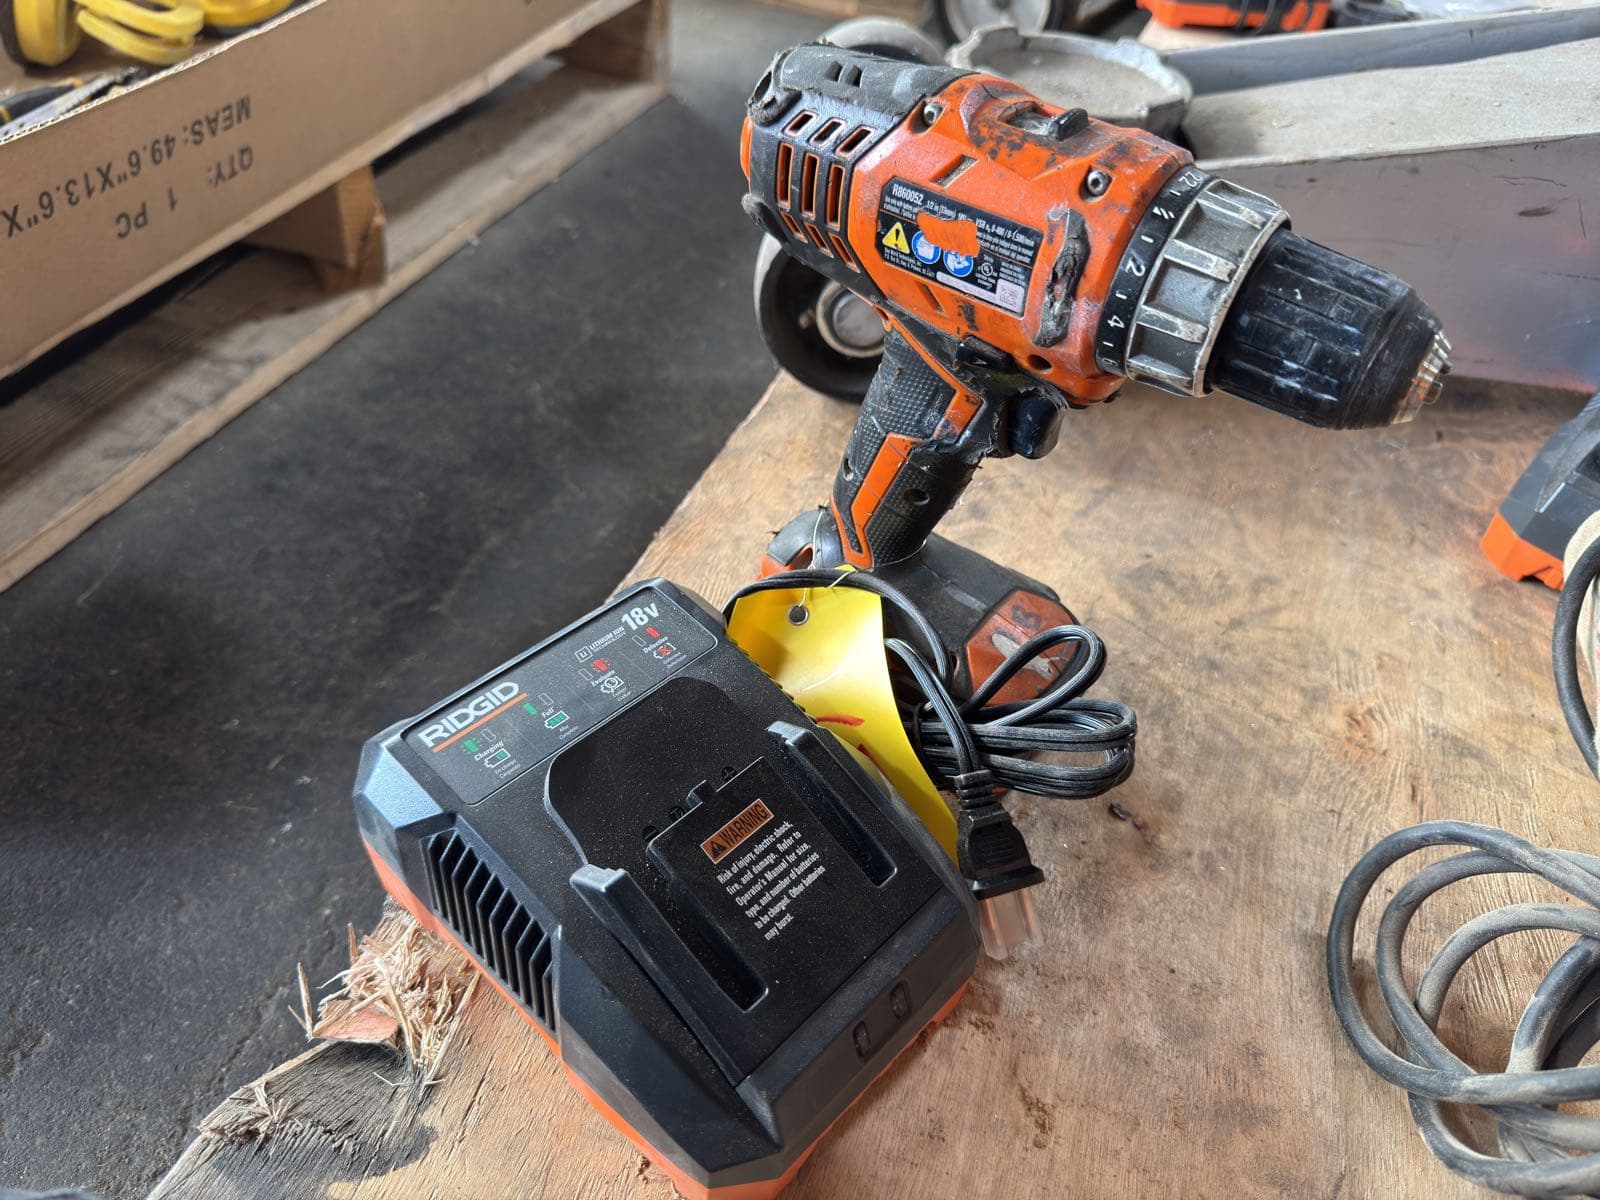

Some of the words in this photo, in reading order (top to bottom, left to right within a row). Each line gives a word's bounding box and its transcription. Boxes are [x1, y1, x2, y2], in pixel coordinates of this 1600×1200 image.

[182, 95, 252, 146] MEAS:
[207, 145, 254, 188] QTY:
[1178, 170, 1202, 188] 22
[167, 187, 178, 211] 1
[892, 183, 924, 205] R860052
[115, 201, 149, 238] PC
[1126, 252, 1146, 277] 2
[1107, 314, 1125, 329] 4
[589, 632, 613, 650] LITHIUM
[612, 625, 624, 636] ION
[593, 630, 626, 652] TECHNOLOGY
[418, 682, 519, 748] RIDGID
[474, 740, 504, 761] Charging
[718, 803, 768, 847] WARNING
[717, 869, 733, 884] Risk
[731, 862, 739, 873] of
[735, 852, 757, 869] injury,
[753, 834, 776, 855] electric
[726, 883, 743, 895] fire,
[740, 869, 754, 884] and
[776, 836, 794, 853] Refer
[792, 831, 802, 839] to
[735, 878, 767, 906] Operator's
[764, 858, 789, 882] Manual
[786, 852, 797, 863] for
[745, 904, 762, 918] type,
[759, 891, 772, 906] and
[769, 876, 791, 897] number
[789, 869, 797, 880] of
[793, 852, 820, 875] batteries
[754, 920, 763, 929] to
[759, 914, 770, 924] be
[768, 895, 791, 918] charged.
[788, 883, 805, 898] Other
[801, 865, 826, 887] batteries
[764, 926, 779, 941] may
[774, 913, 794, 930] burst.
